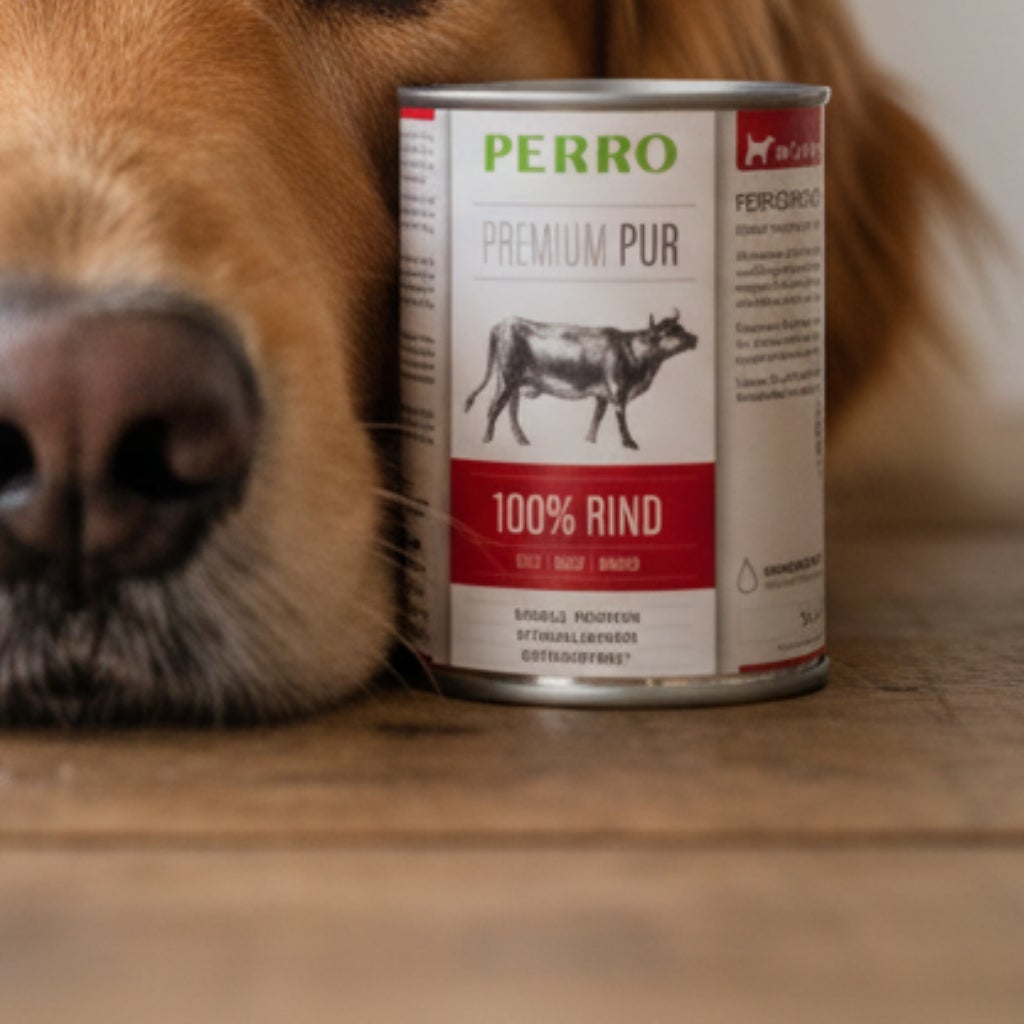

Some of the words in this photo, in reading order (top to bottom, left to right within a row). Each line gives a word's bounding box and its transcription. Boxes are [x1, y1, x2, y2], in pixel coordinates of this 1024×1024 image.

[484, 133, 678, 173] PERRO
[484, 221, 607, 266] PREMIUM
[620, 223, 678, 266] PUR
[493, 492, 576, 536] 100%
[588, 495, 663, 537] RIND
